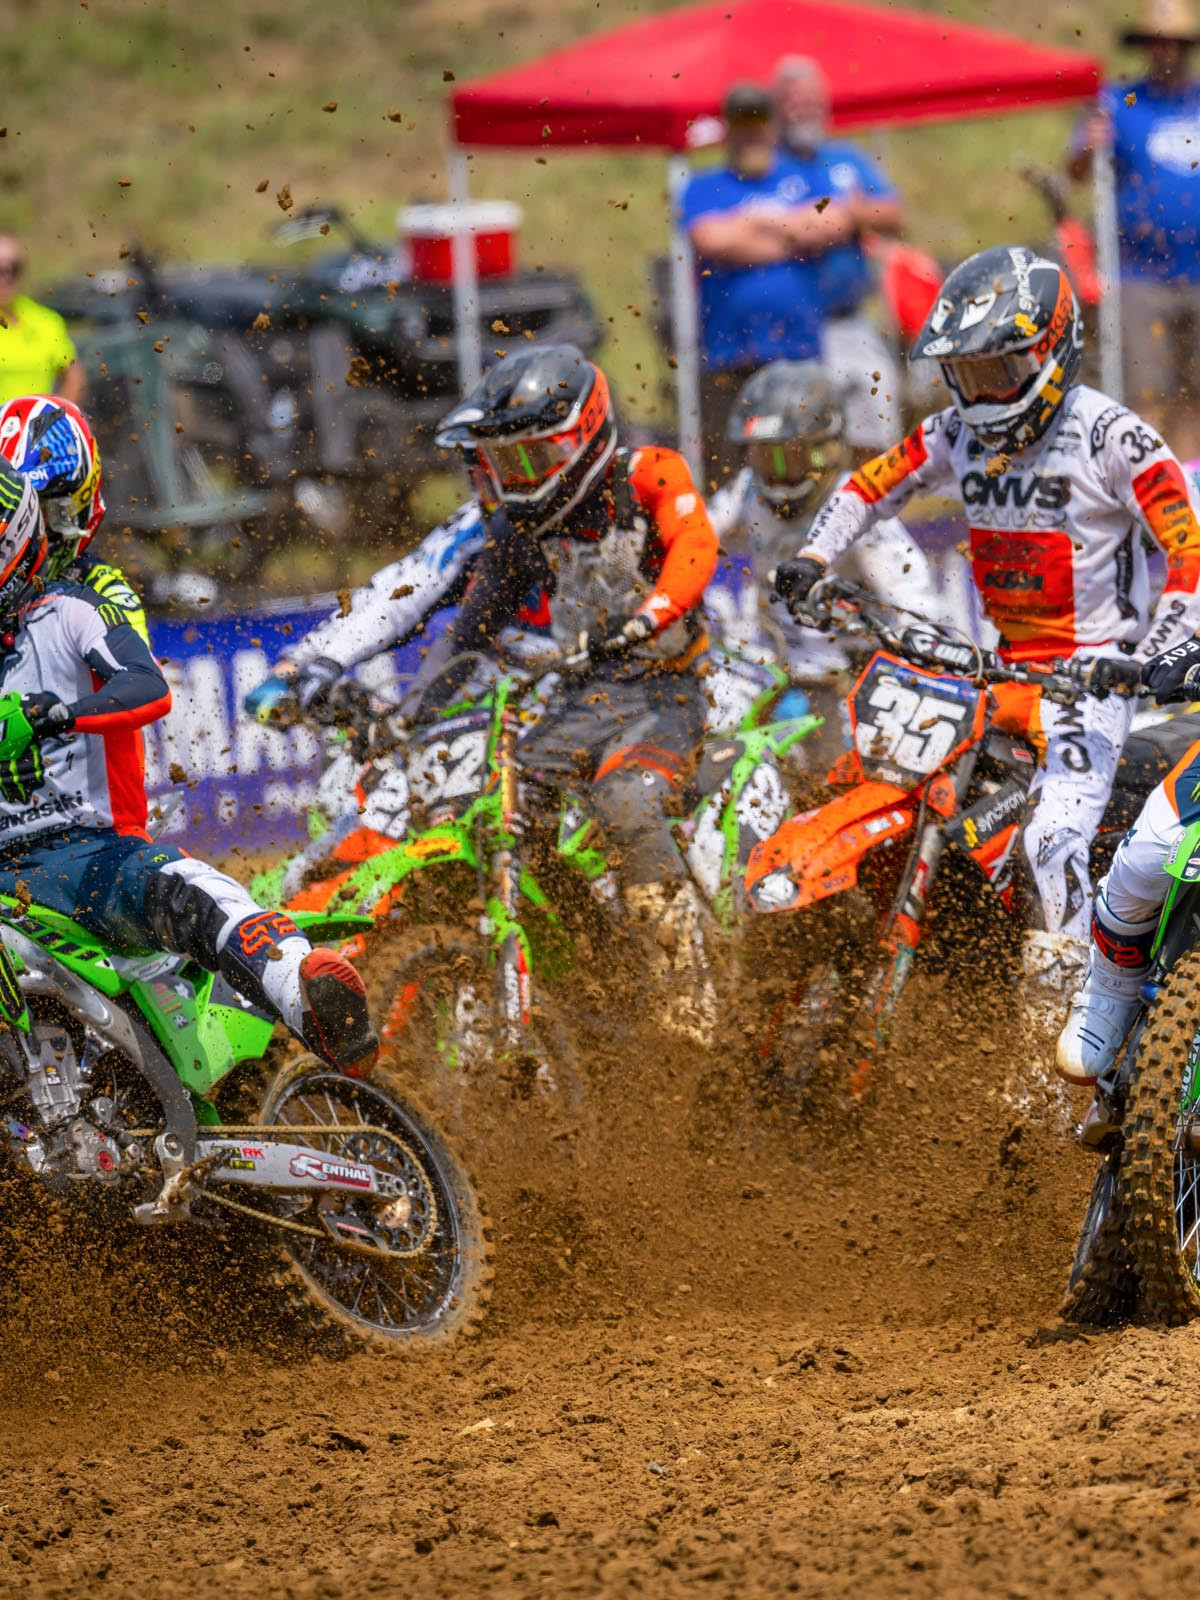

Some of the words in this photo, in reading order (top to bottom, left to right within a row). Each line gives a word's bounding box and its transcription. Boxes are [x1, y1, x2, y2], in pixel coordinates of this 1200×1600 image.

[1120, 425, 1156, 464] 35
[1159, 641, 1200, 668] FOX
[857, 683, 968, 775] 35
